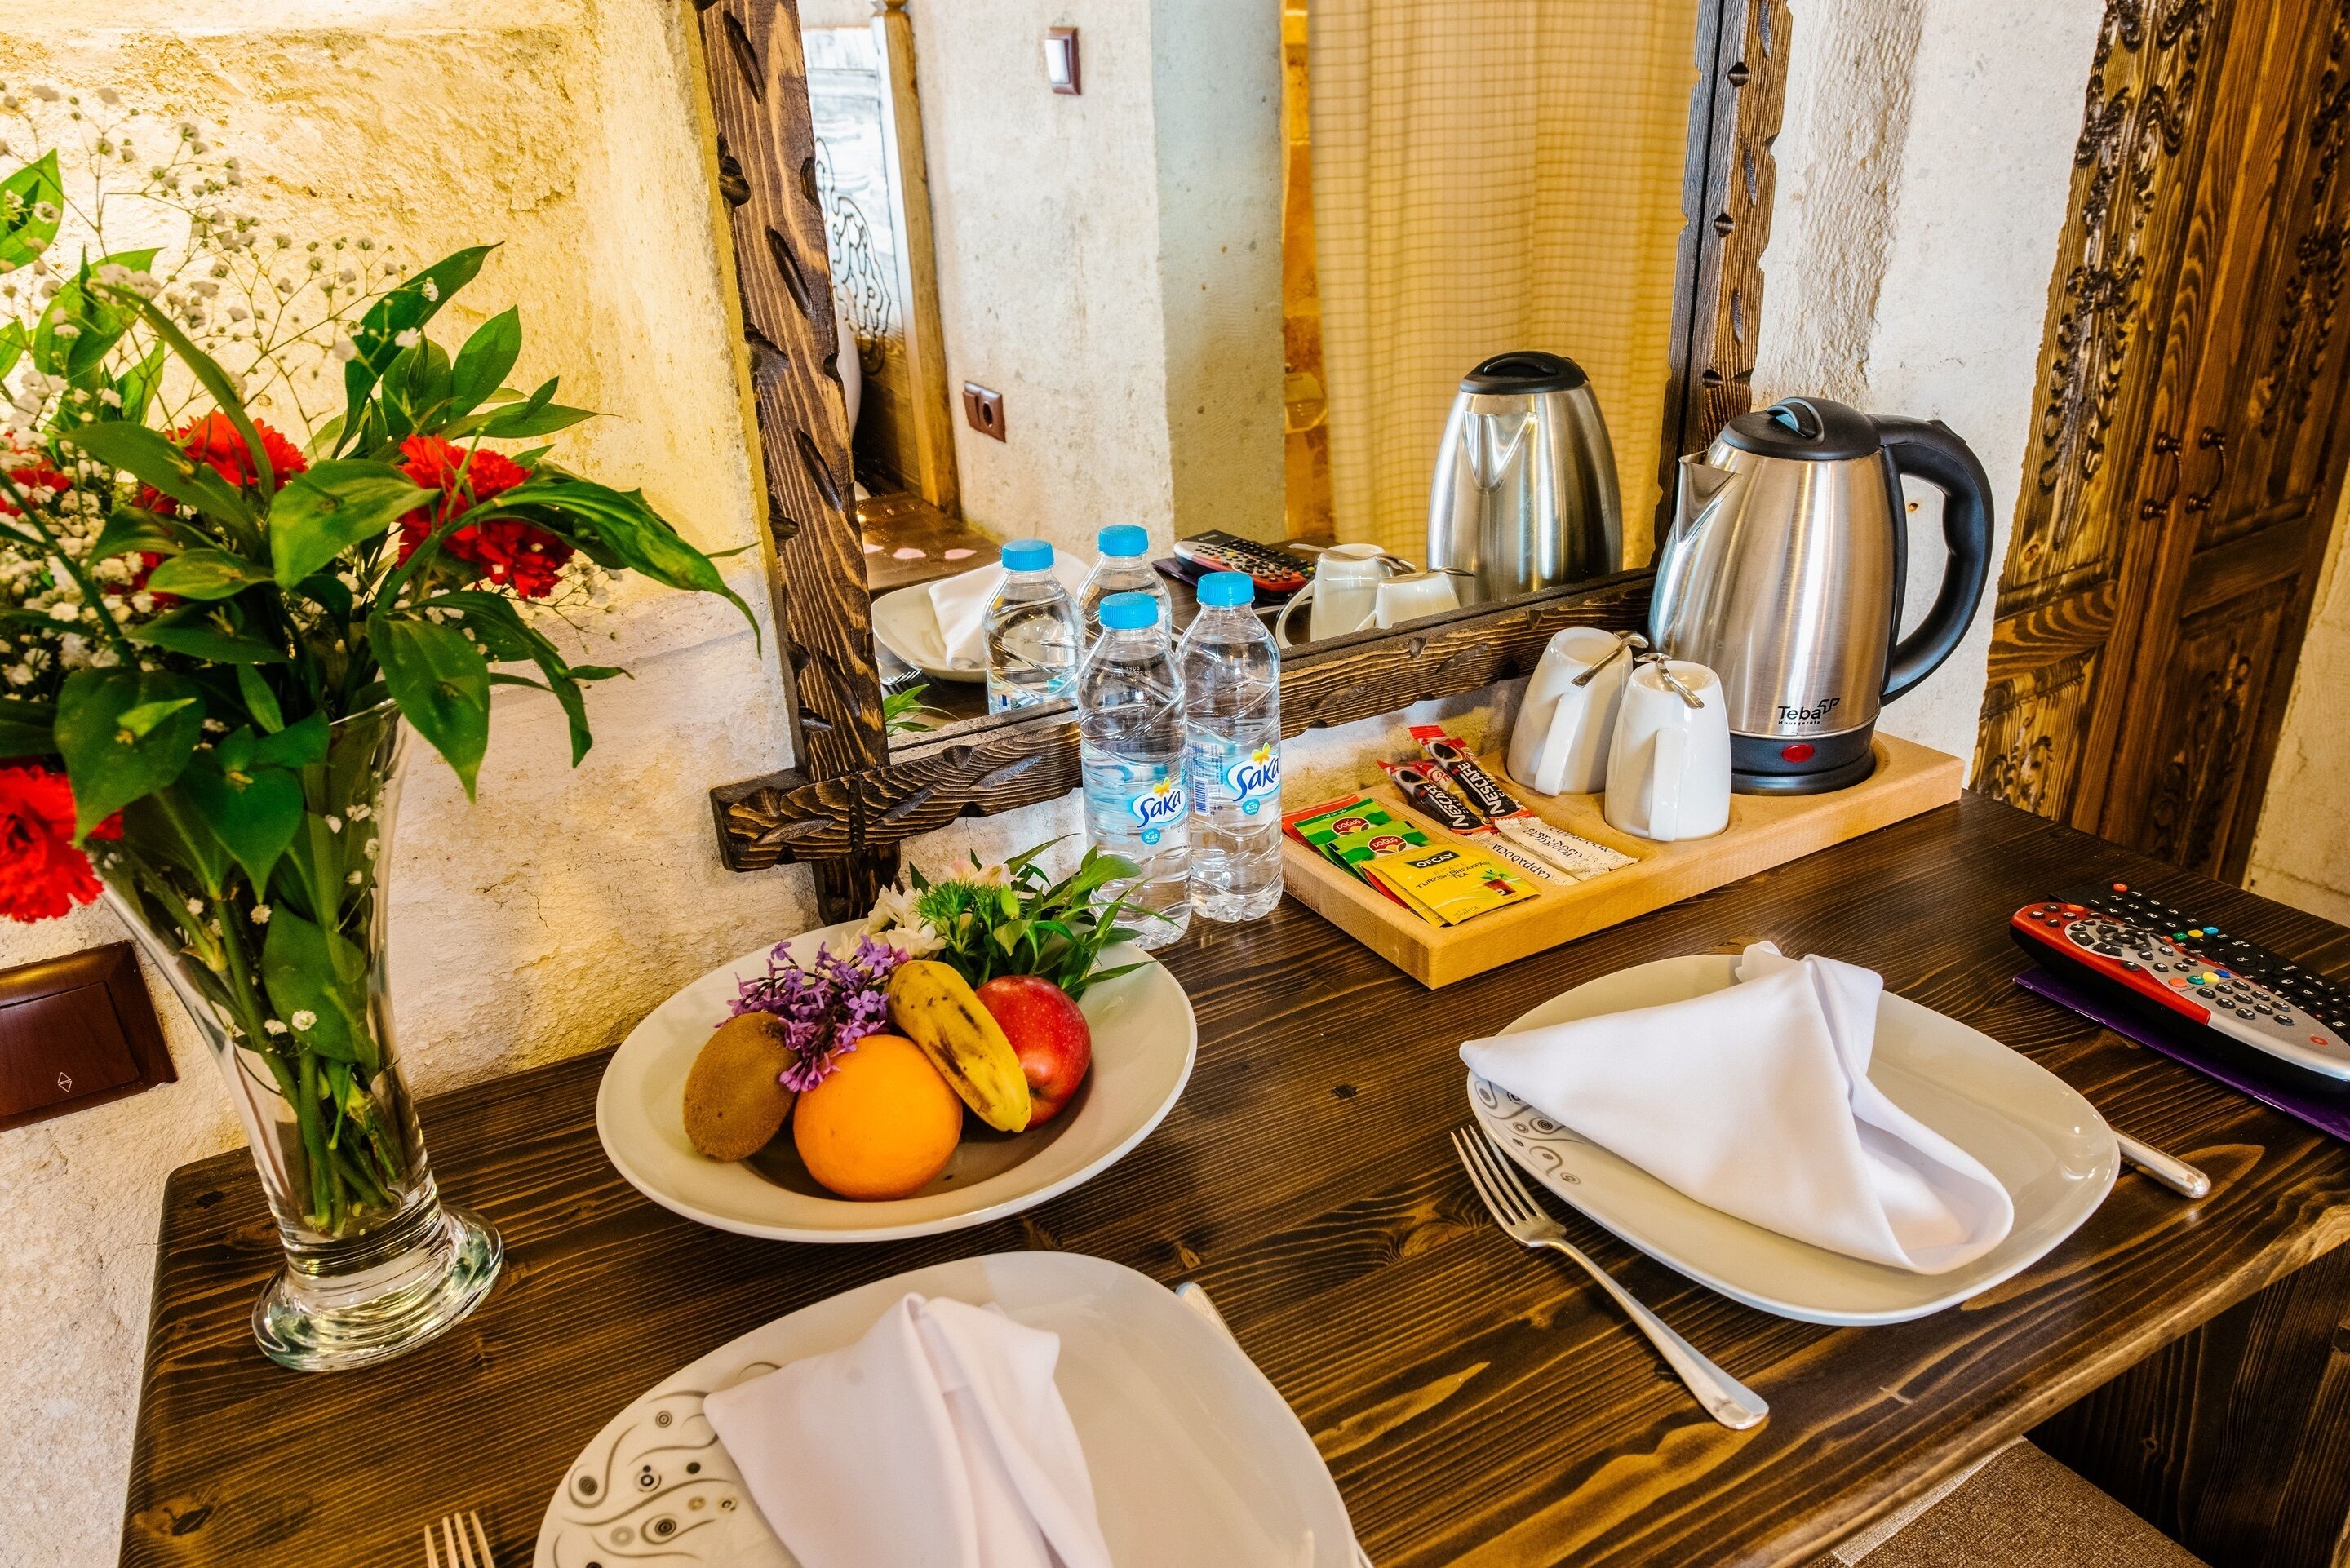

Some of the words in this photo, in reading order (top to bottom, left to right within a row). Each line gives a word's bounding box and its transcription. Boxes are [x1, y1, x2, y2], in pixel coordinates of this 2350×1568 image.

[1777, 706, 1821, 720] Teba
[1233, 757, 1279, 802] Saka
[1137, 790, 1182, 828] Saka
[1416, 853, 1455, 867] OFÇAY
[1416, 873, 1450, 889] TURKISH
